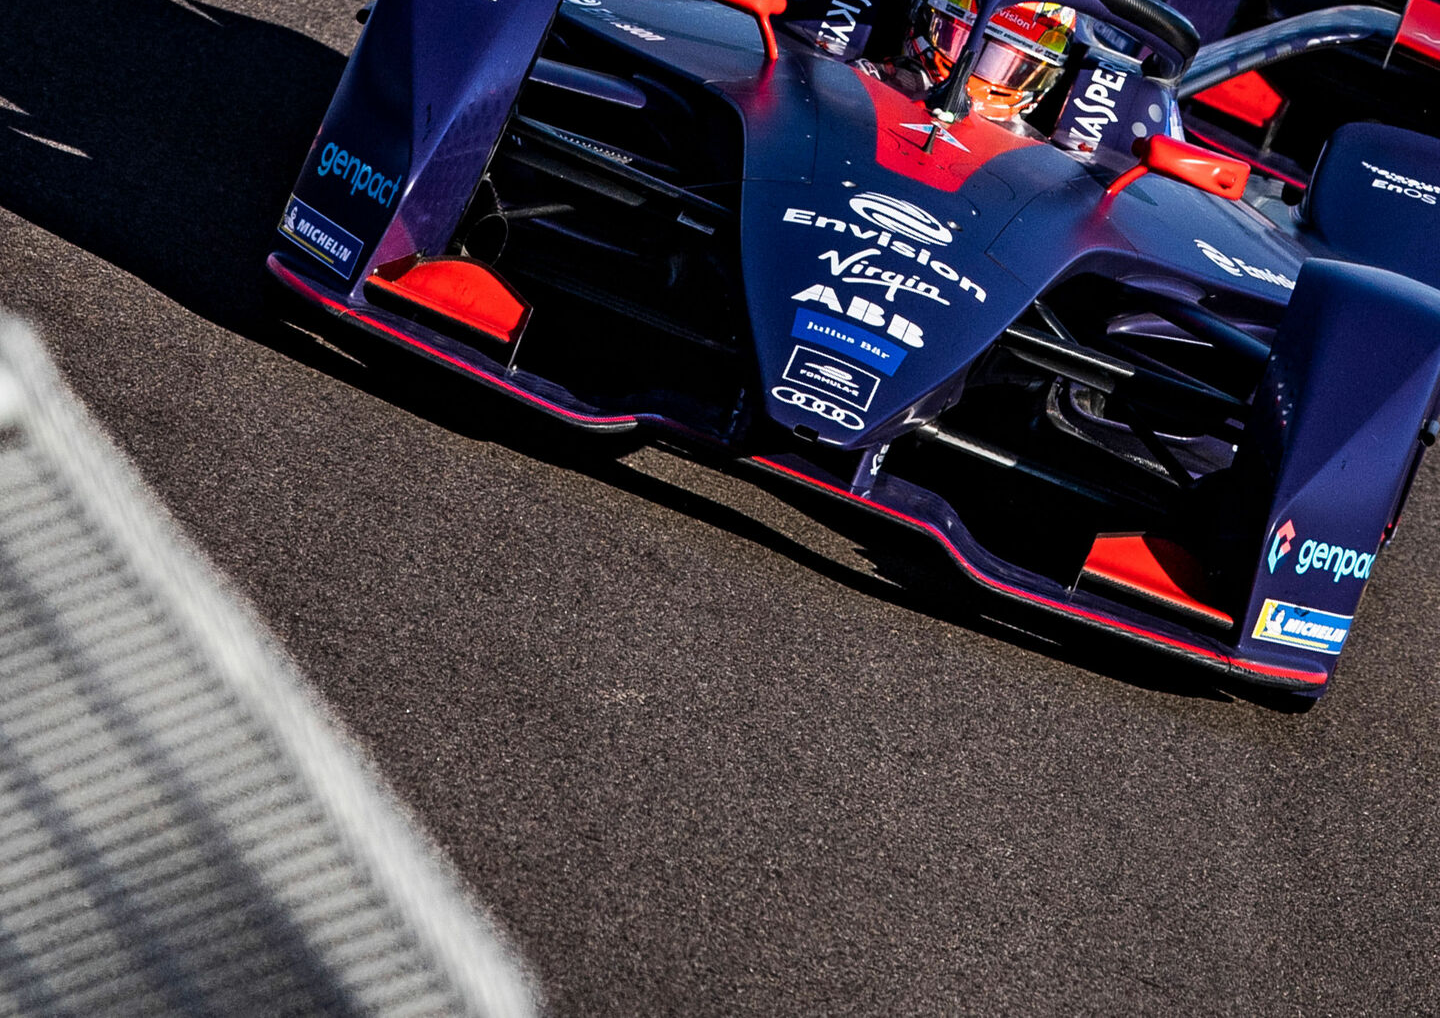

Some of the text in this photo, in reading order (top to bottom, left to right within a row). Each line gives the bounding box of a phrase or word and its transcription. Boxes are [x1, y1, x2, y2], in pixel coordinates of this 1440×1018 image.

[999, 9, 1031, 31] vision
[1069, 69, 1128, 143] KASPE
[317, 141, 402, 208] genpact
[1371, 178, 1437, 205] EnOS
[296, 218, 352, 262] MICHELIN
[782, 207, 987, 303] Envision
[818, 248, 951, 306] Virgin
[791, 284, 925, 349] ABB
[806, 320, 855, 345] Julius
